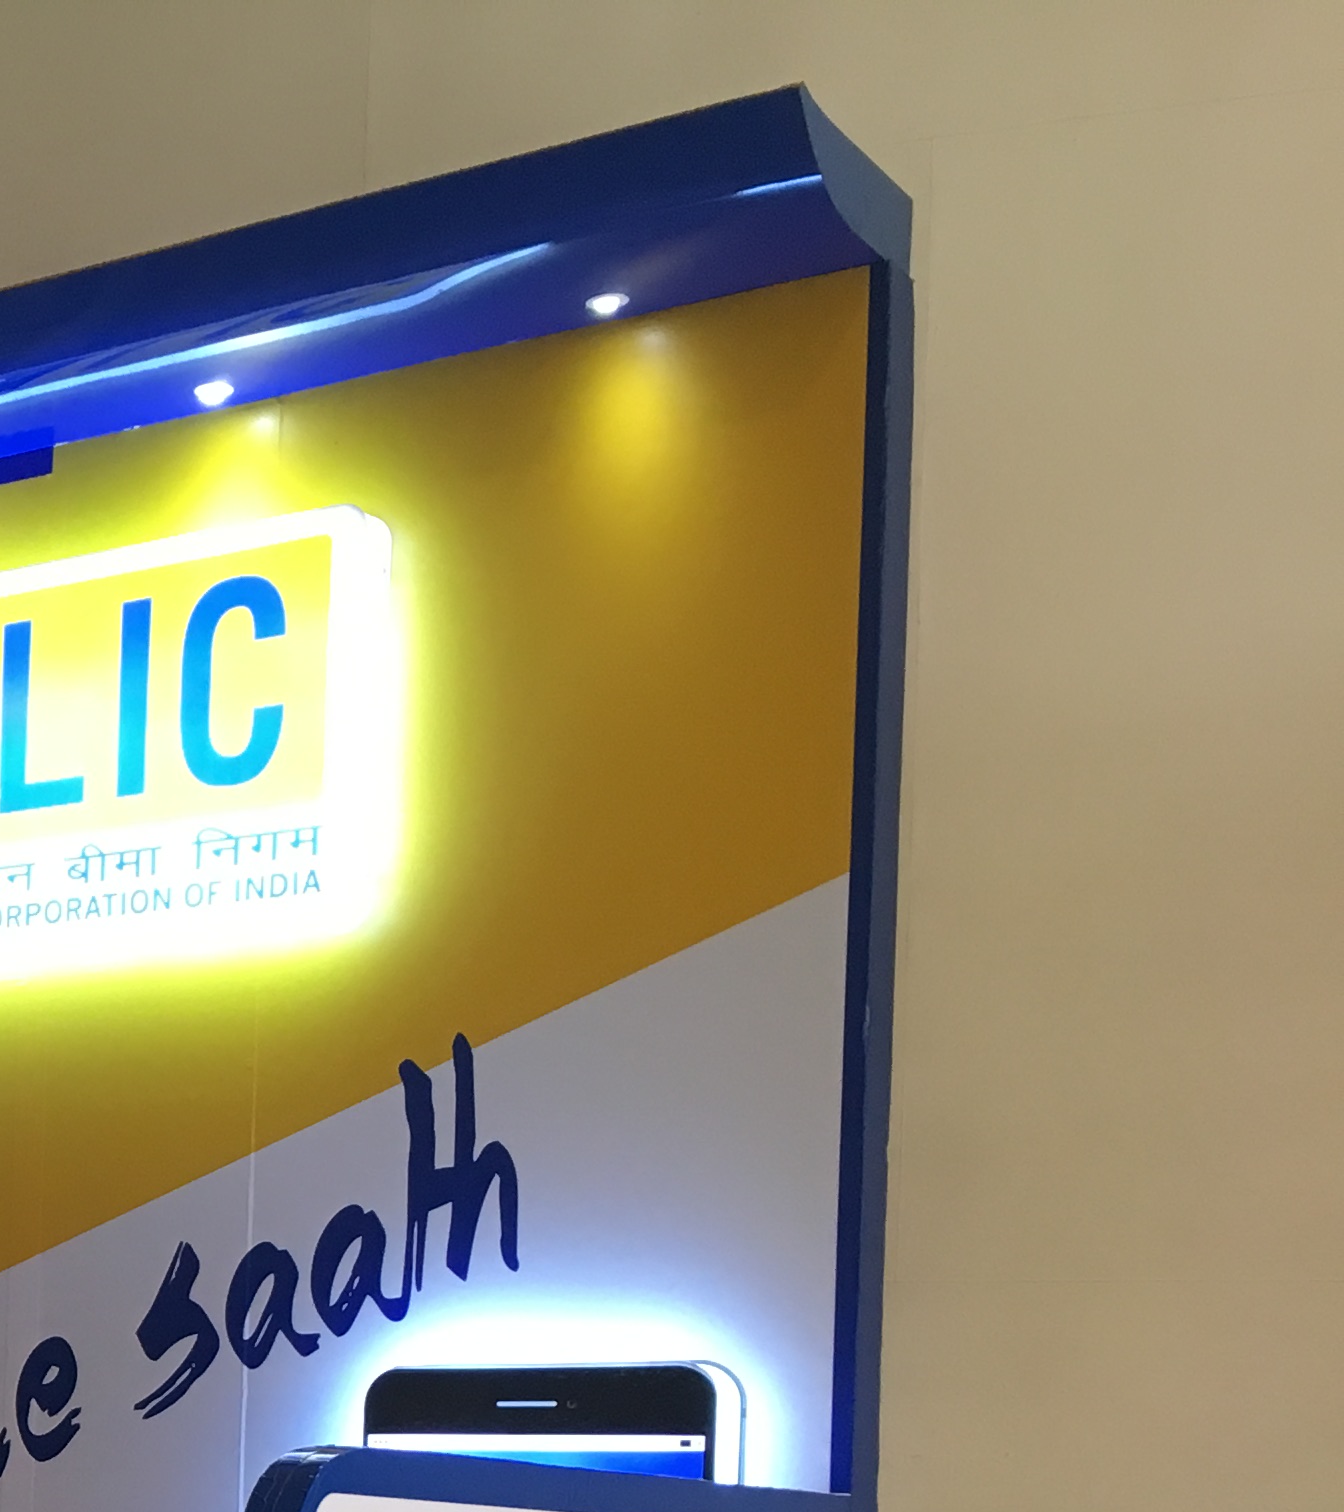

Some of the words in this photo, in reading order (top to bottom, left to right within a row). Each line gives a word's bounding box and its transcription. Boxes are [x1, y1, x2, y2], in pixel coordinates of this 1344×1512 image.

[66, 846, 162, 885] बीमा
[194, 825, 321, 870] निगम
[184, 882, 219, 907] OF
[234, 869, 322, 902] INDIA
[134, 1032, 521, 1421] saath
